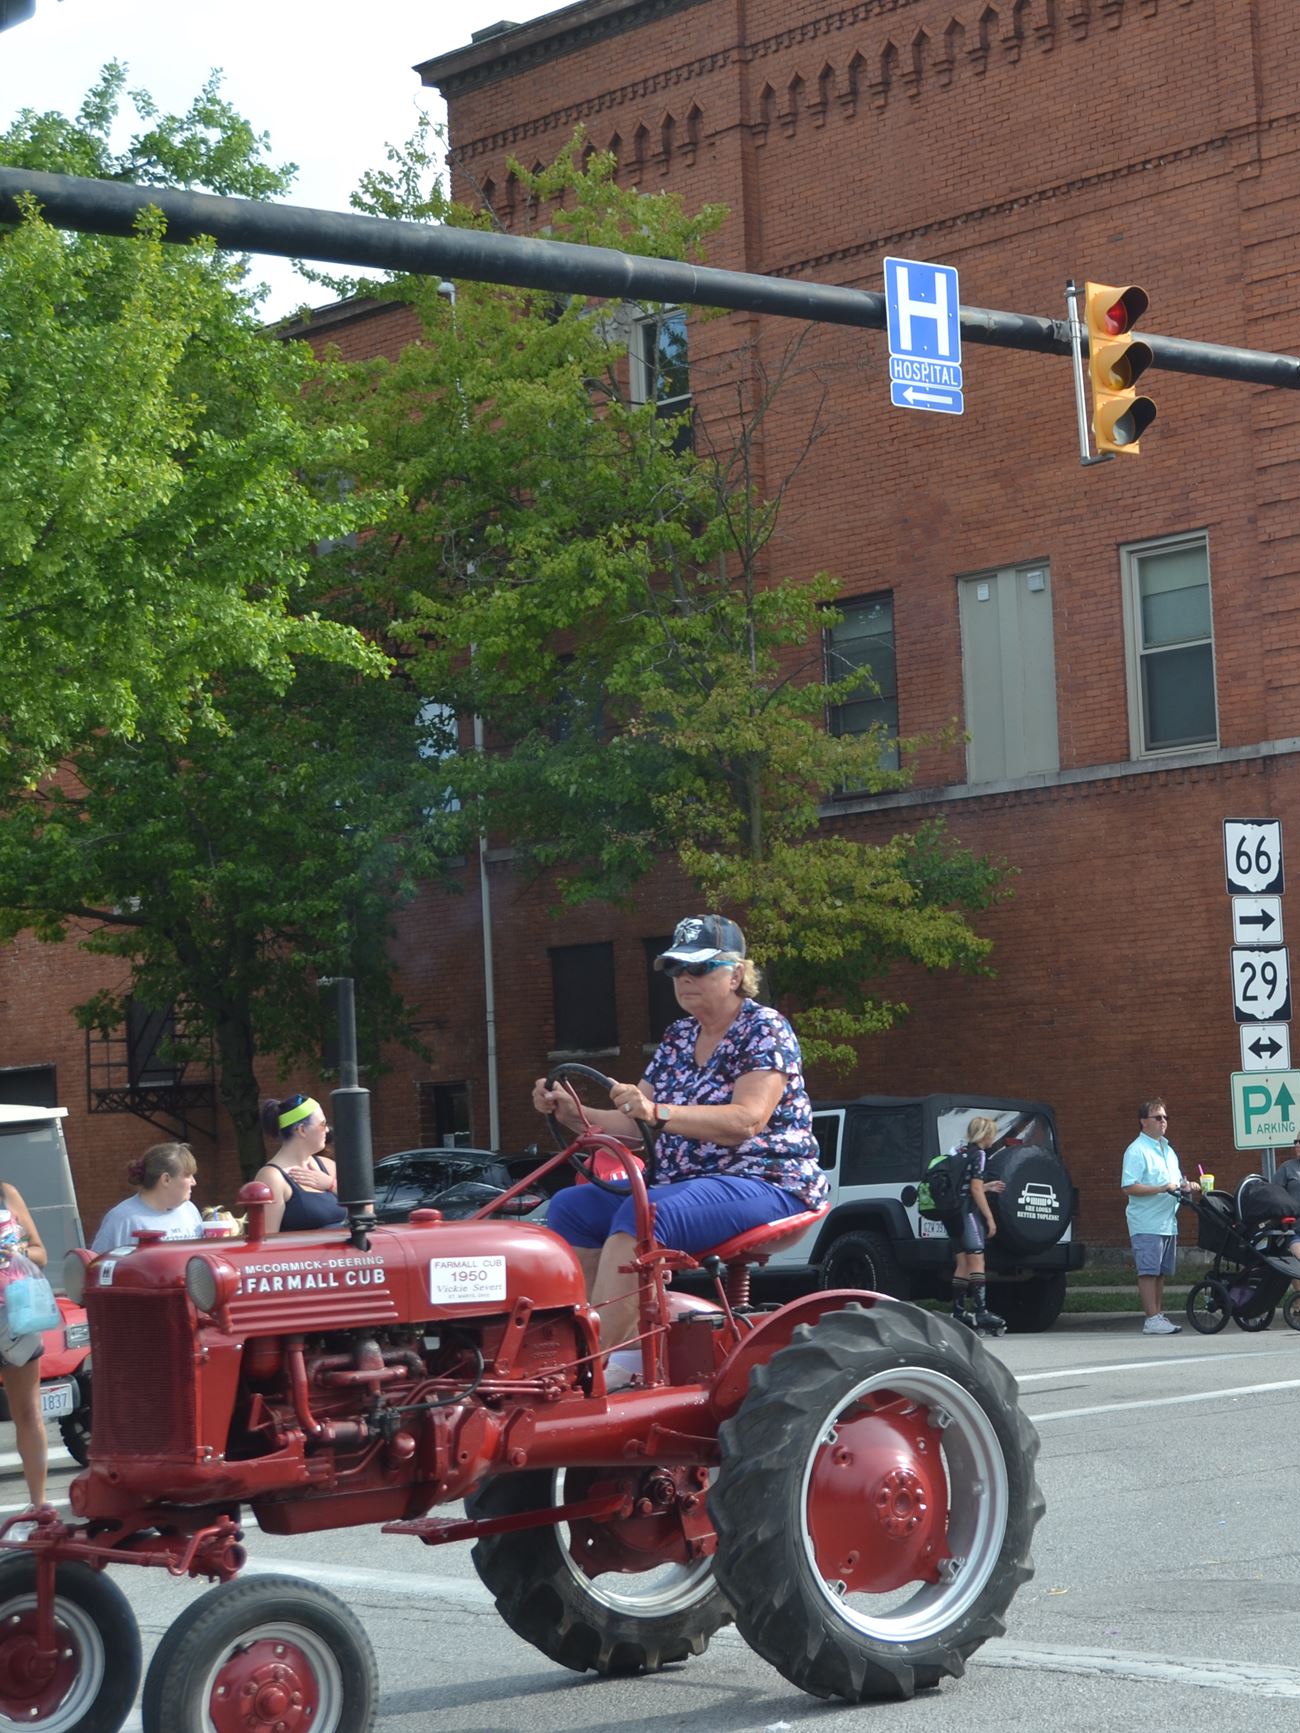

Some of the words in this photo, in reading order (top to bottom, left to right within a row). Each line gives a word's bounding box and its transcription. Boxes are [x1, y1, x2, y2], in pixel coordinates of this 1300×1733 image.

[896, 265, 950, 357] H
[894, 360, 958, 385] HOSPITAL
[1236, 835, 1272, 875] 66
[1240, 961, 1278, 1002] 29
[1242, 1085, 1297, 1135] PARKING
[434, 1260, 478, 1269] FARMALL
[482, 1259, 503, 1267] CUB
[451, 1270, 488, 1282] 1950
[247, 1272, 339, 1293] FARMALL
[345, 1268, 386, 1285] CUB
[43, 1392, 67, 1411] 1837
